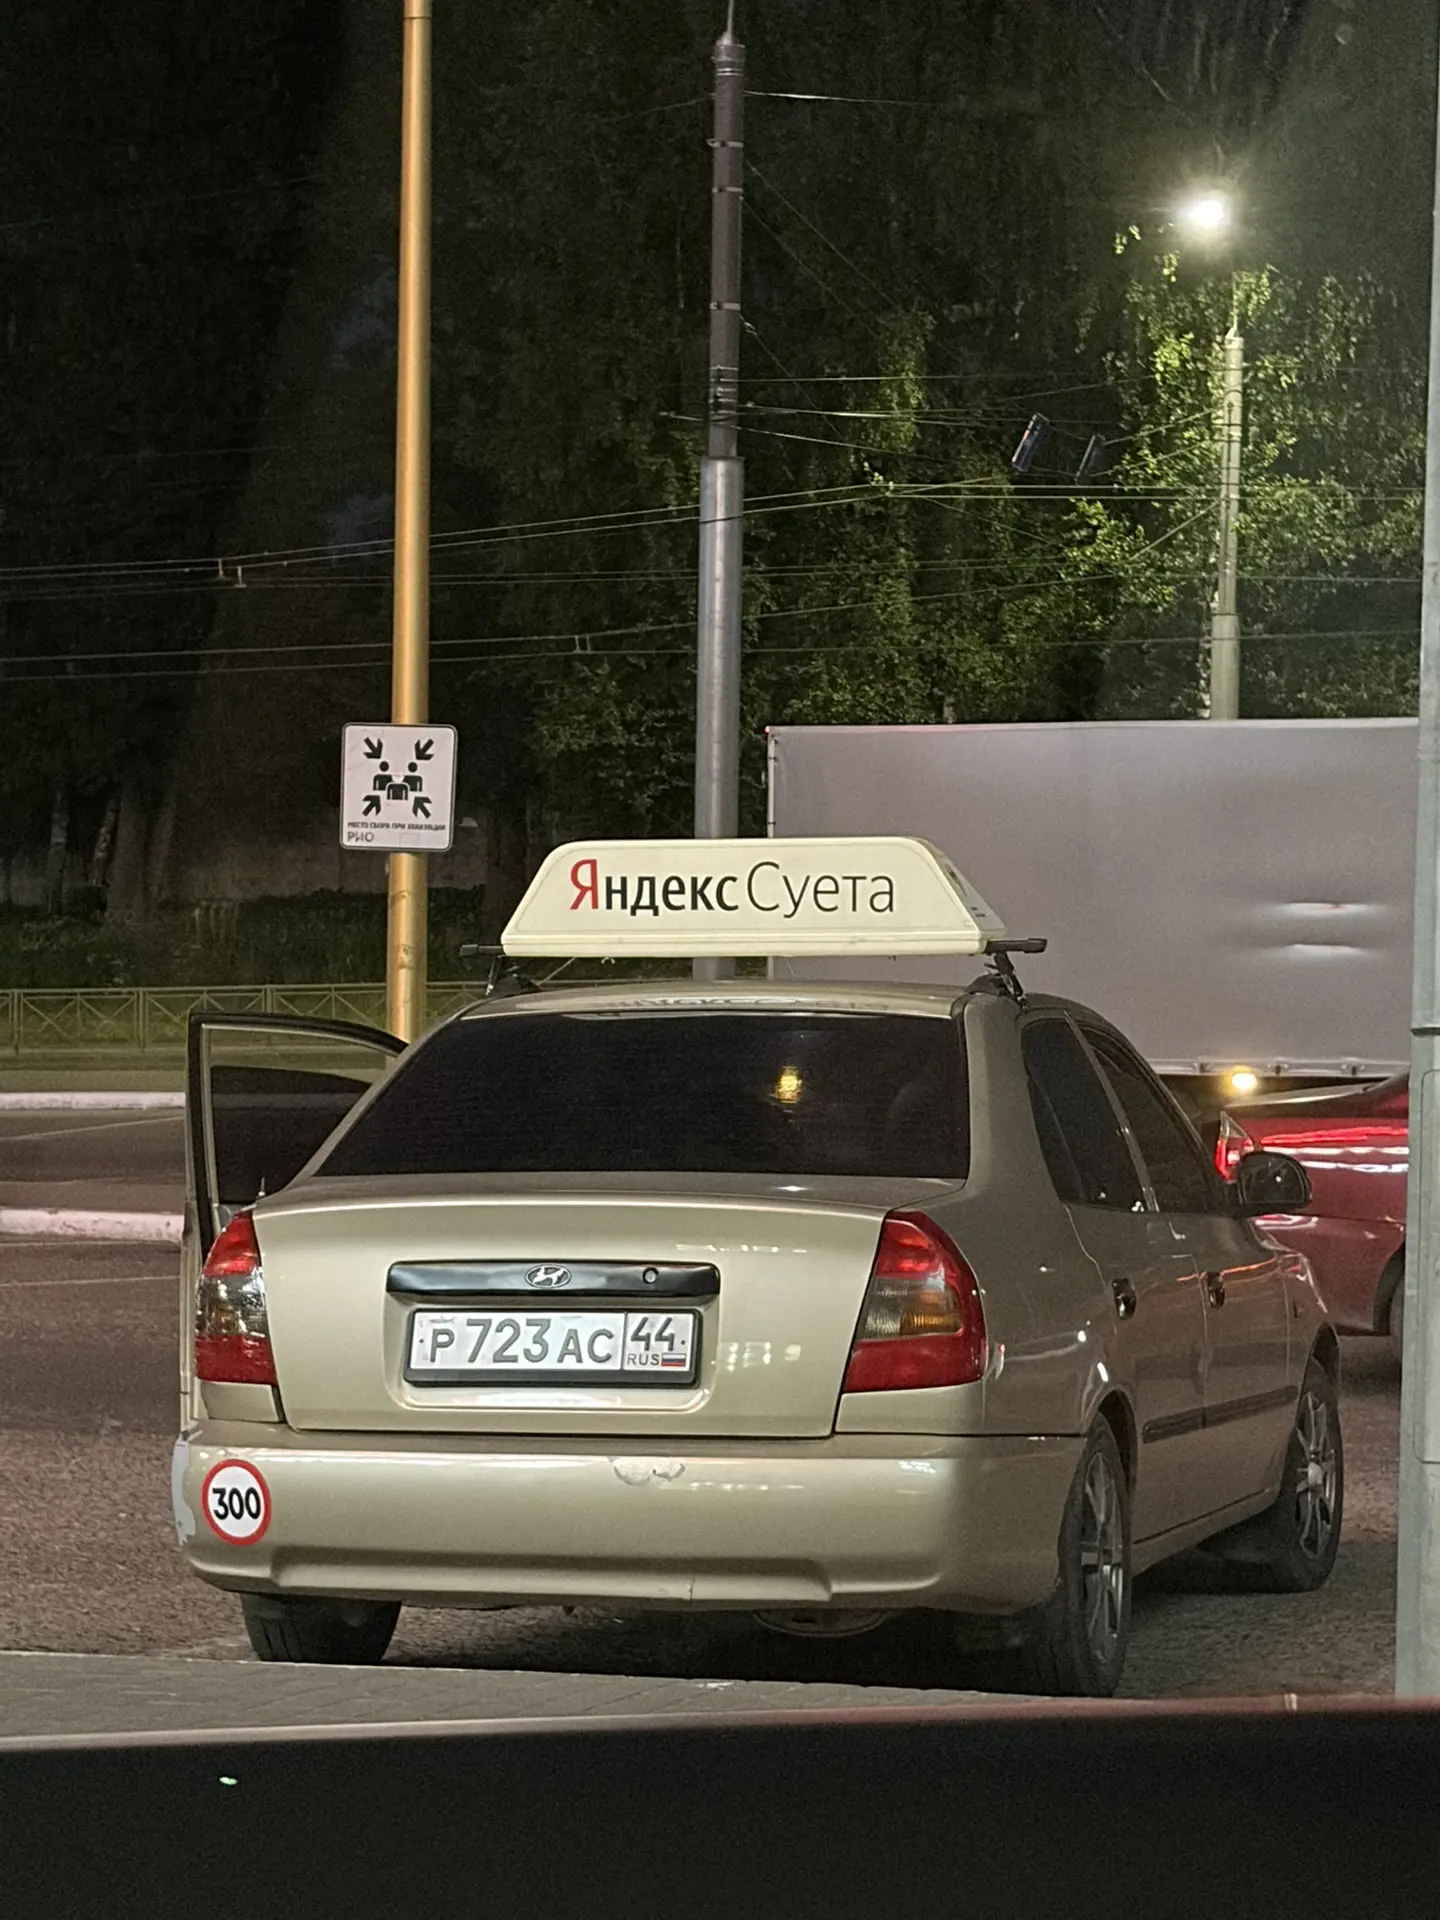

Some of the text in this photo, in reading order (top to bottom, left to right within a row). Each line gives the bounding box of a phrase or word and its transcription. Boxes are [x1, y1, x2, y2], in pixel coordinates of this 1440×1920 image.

[347, 831, 374, 842] РИО
[570, 859, 895, 918] Яндекс Суета
[630, 1316, 675, 1351] 44
[627, 1353, 660, 1366] RUS
[212, 1487, 261, 1520] 300
